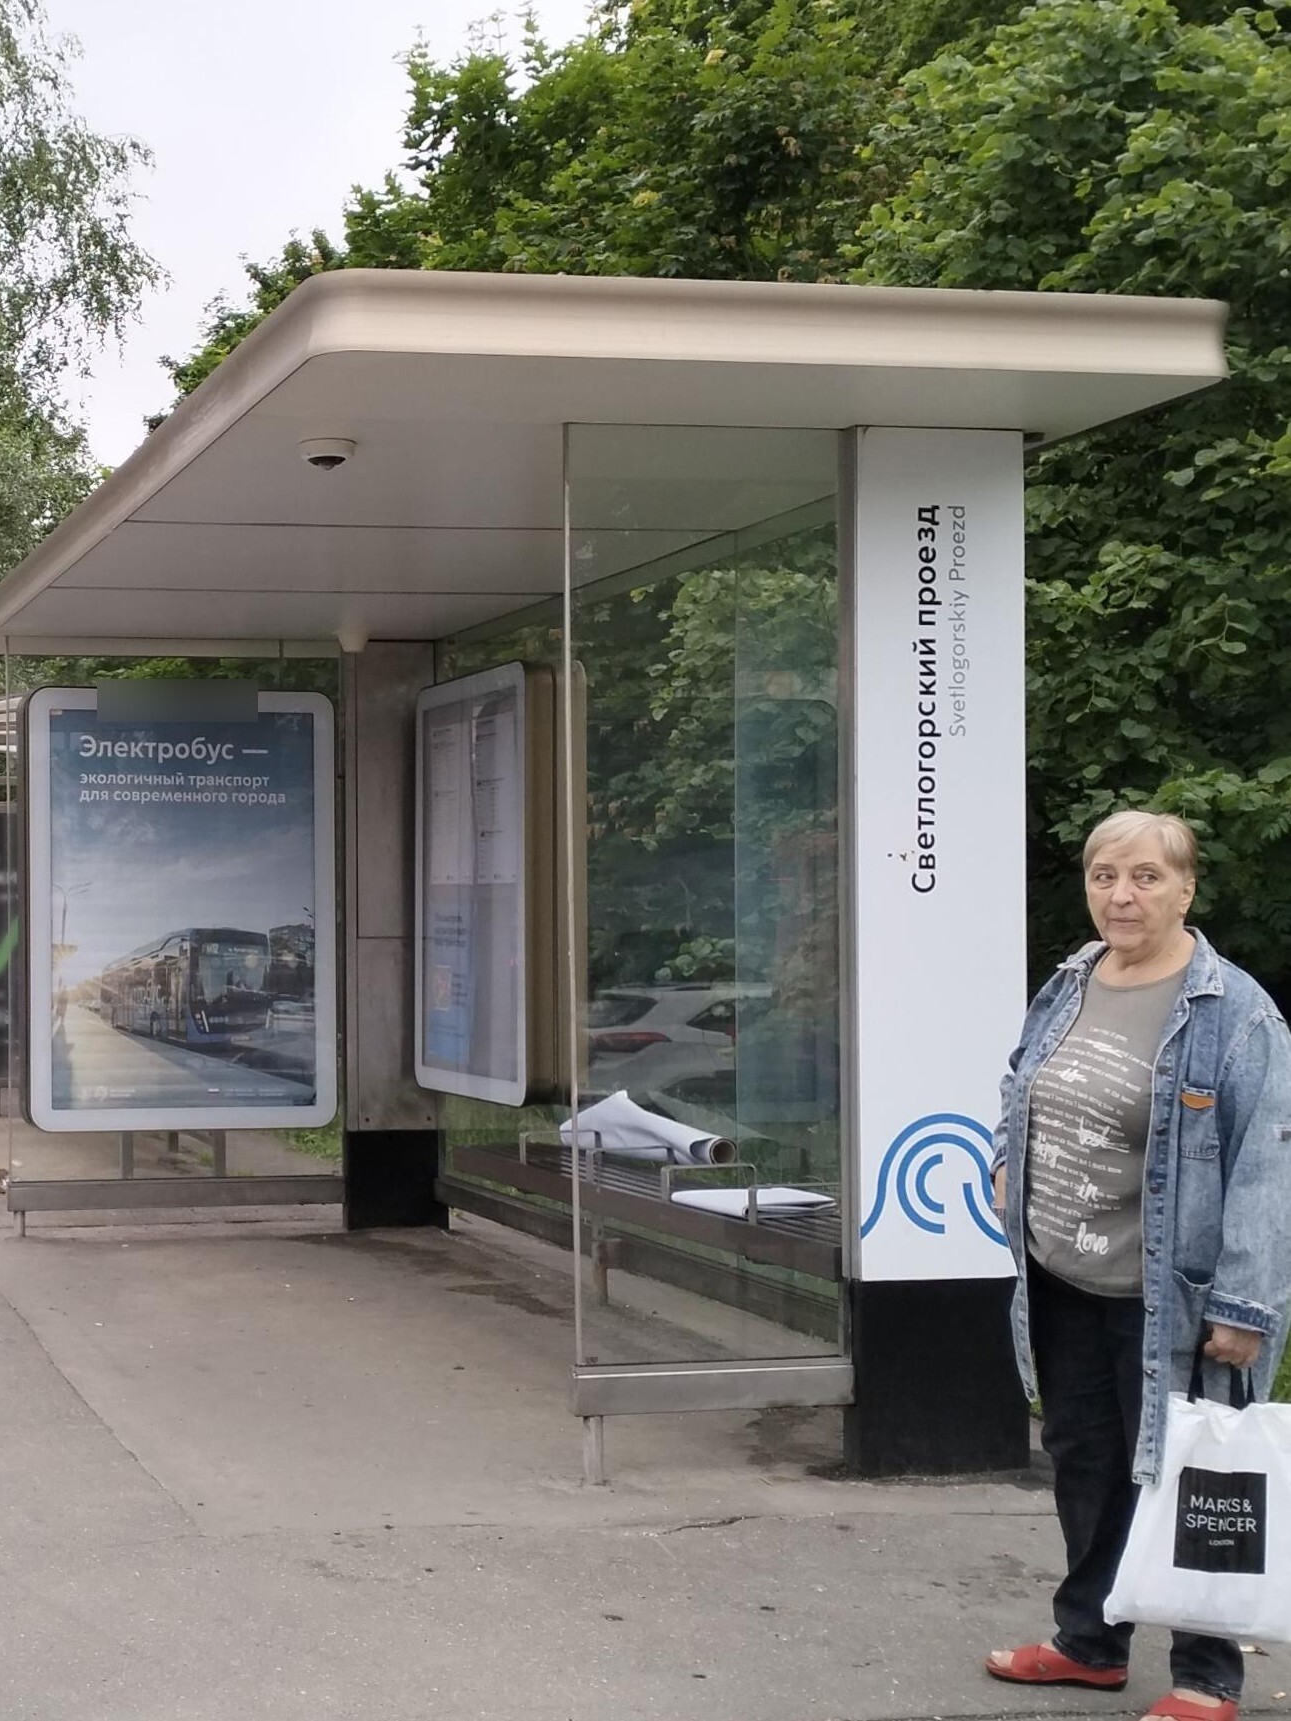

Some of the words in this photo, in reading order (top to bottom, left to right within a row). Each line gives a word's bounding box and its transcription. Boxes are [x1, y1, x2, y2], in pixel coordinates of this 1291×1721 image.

[948, 504, 968, 582] Proezd
[917, 504, 943, 627] проезд
[948, 589, 971, 737] Svetlogorskiy
[79, 734, 235, 765] Электробус
[911, 638, 943, 894] Светлогорский
[79, 771, 185, 787] экологичный
[187, 775, 270, 790] транспорт
[79, 789, 109, 803] для
[112, 789, 228, 805] современного
[231, 792, 287, 807] города
[1075, 1221, 1109, 1255] love
[1185, 1513, 1258, 1533] SPENCER
